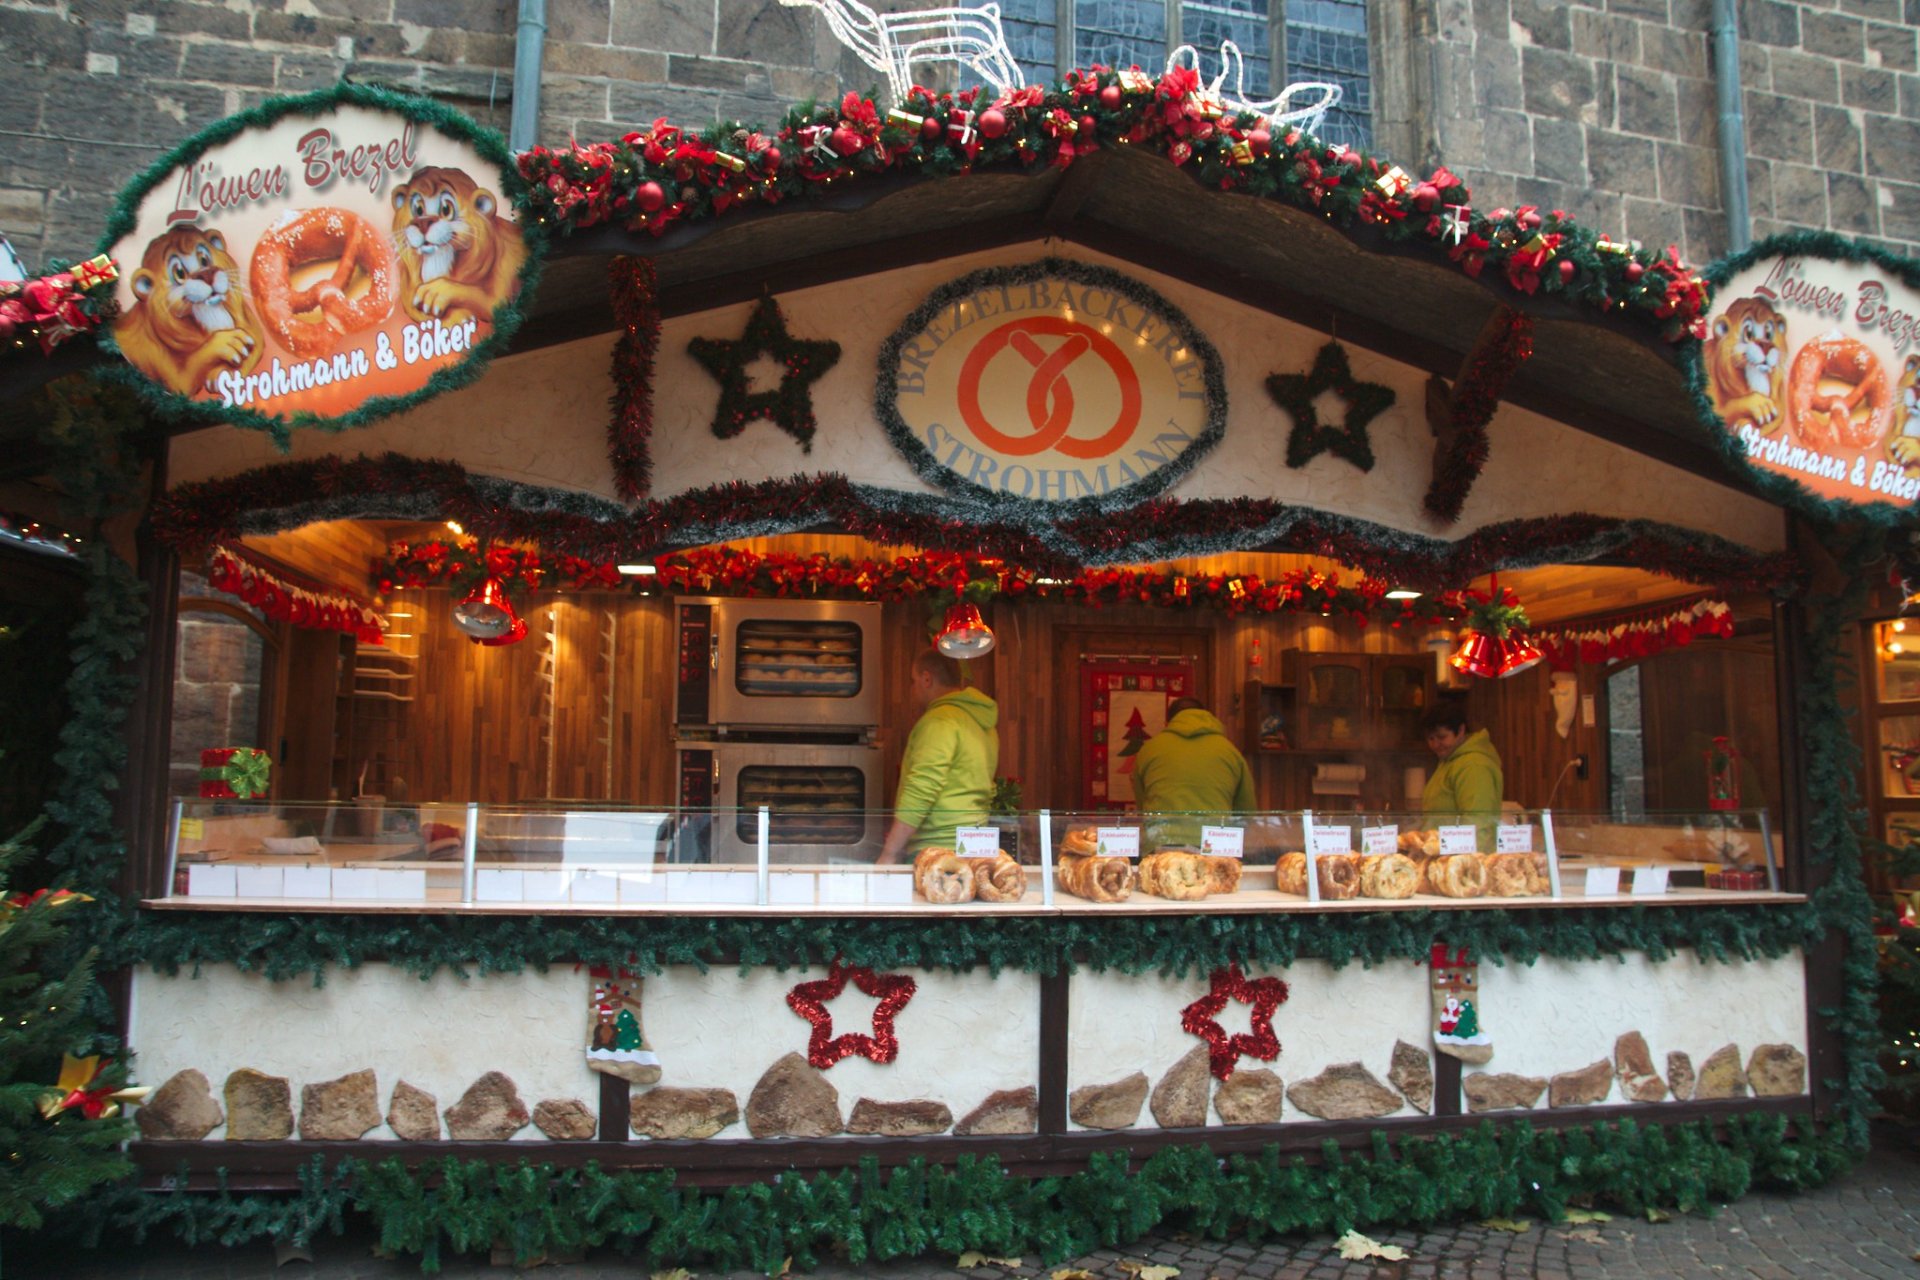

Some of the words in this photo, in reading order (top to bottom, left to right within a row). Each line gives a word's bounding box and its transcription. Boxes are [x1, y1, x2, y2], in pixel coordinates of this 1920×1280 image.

[166, 160, 286, 226] Löwen
[296, 121, 417, 194] Brezel
[1753, 255, 1844, 315] Löwen
[1855, 280, 1920, 350] Breze
[216, 347, 370, 409] Strohmann
[375, 331, 398, 371] &
[402, 316, 478, 365] Böker
[927, 418, 1194, 498] STROHMANN
[1739, 423, 1847, 481] Strohmann
[1850, 455, 1866, 487] &
